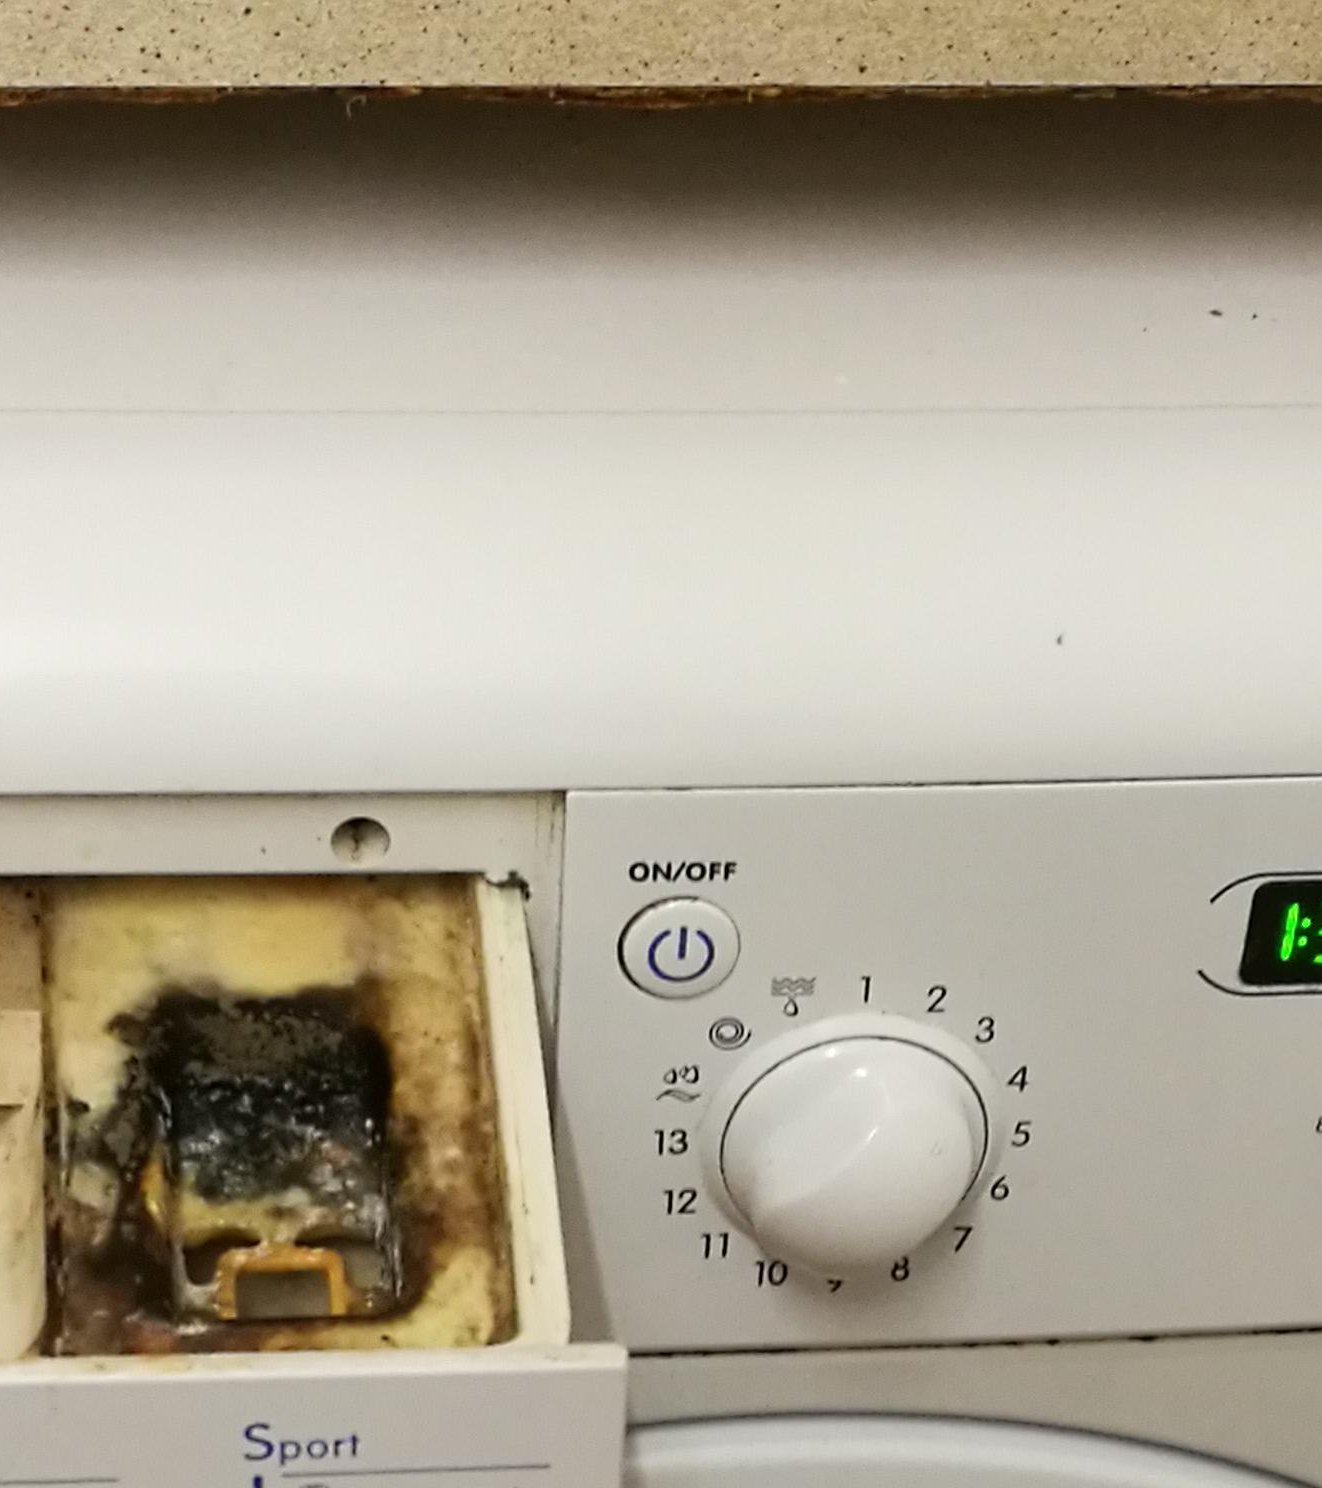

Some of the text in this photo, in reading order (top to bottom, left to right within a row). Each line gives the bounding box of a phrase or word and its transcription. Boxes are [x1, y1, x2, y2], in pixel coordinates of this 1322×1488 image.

[628, 861, 737, 883] ON/OFF
[860, 976, 873, 1003] 1
[926, 985, 948, 1014] 2
[975, 1016, 996, 1043] 3
[1007, 1065, 1029, 1093] 4
[653, 1129, 689, 1156] 13
[1012, 1120, 1032, 1148] 5
[989, 1174, 1010, 1201] 6
[664, 1188, 698, 1215] 12
[700, 1232, 730, 1259] 11
[954, 1226, 973, 1252] 7
[755, 1260, 789, 1287] 10
[242, 1422, 361, 1465] Sport
